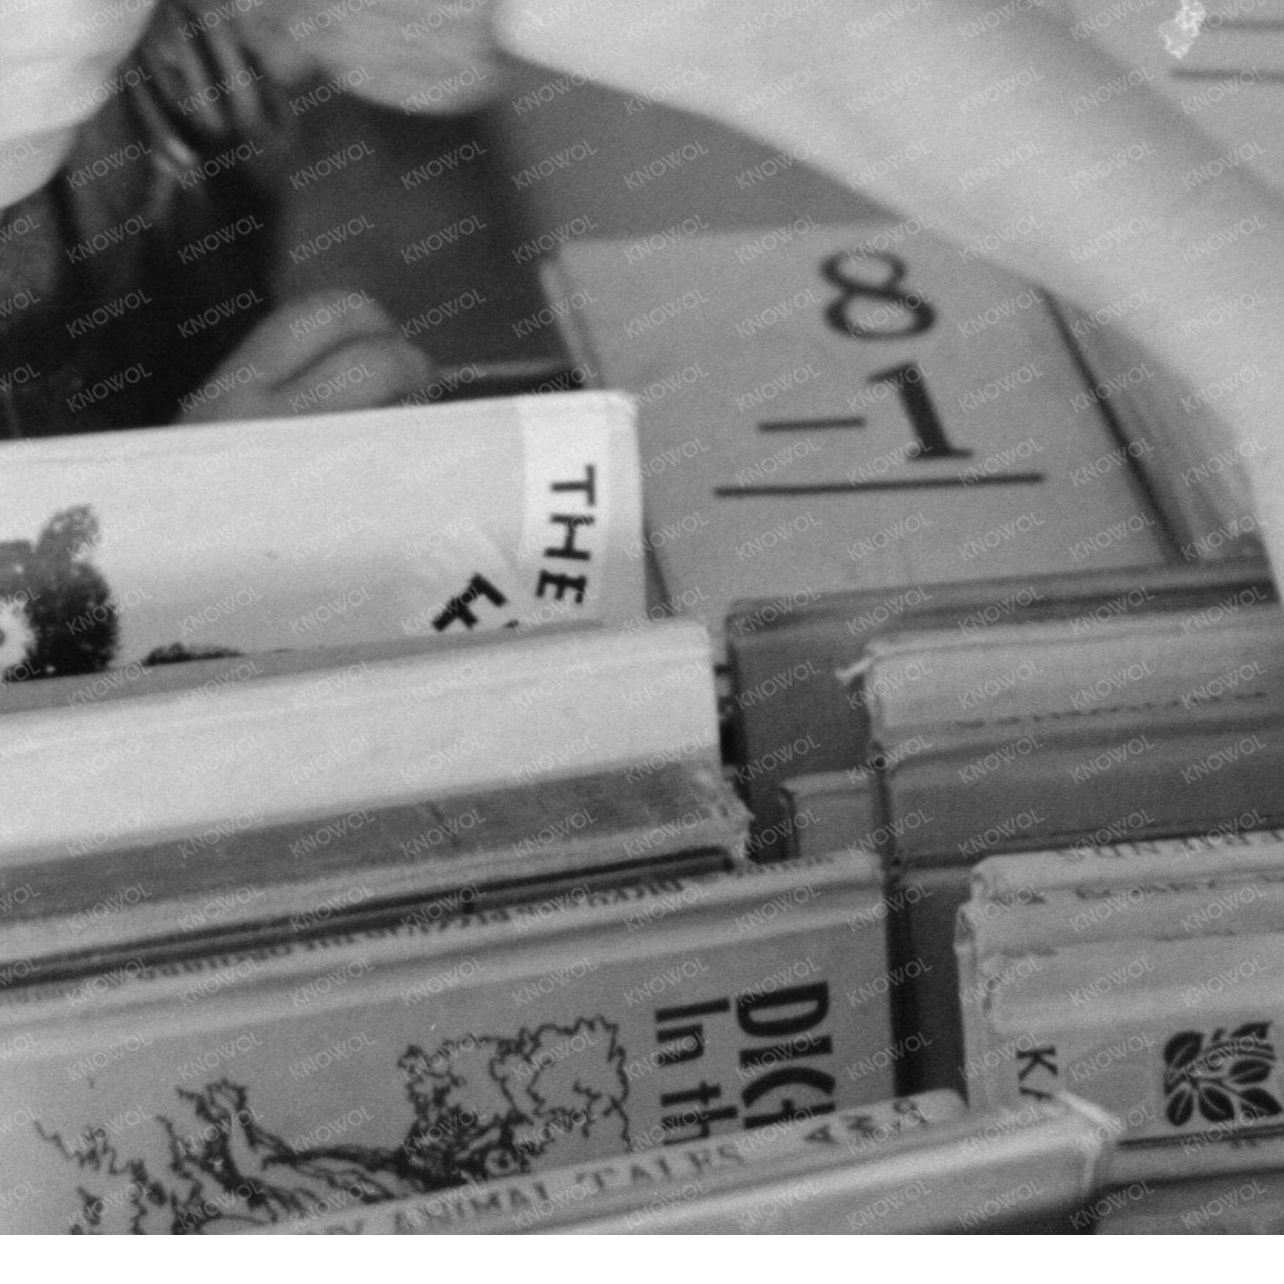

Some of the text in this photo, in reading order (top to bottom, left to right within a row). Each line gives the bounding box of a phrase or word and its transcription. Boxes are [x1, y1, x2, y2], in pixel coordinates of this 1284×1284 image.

[819, 249, 938, 341] 8
[536, 464, 596, 605] THE
[655, 997, 731, 1067] In
[575, 1142, 749, 1193] TALES
